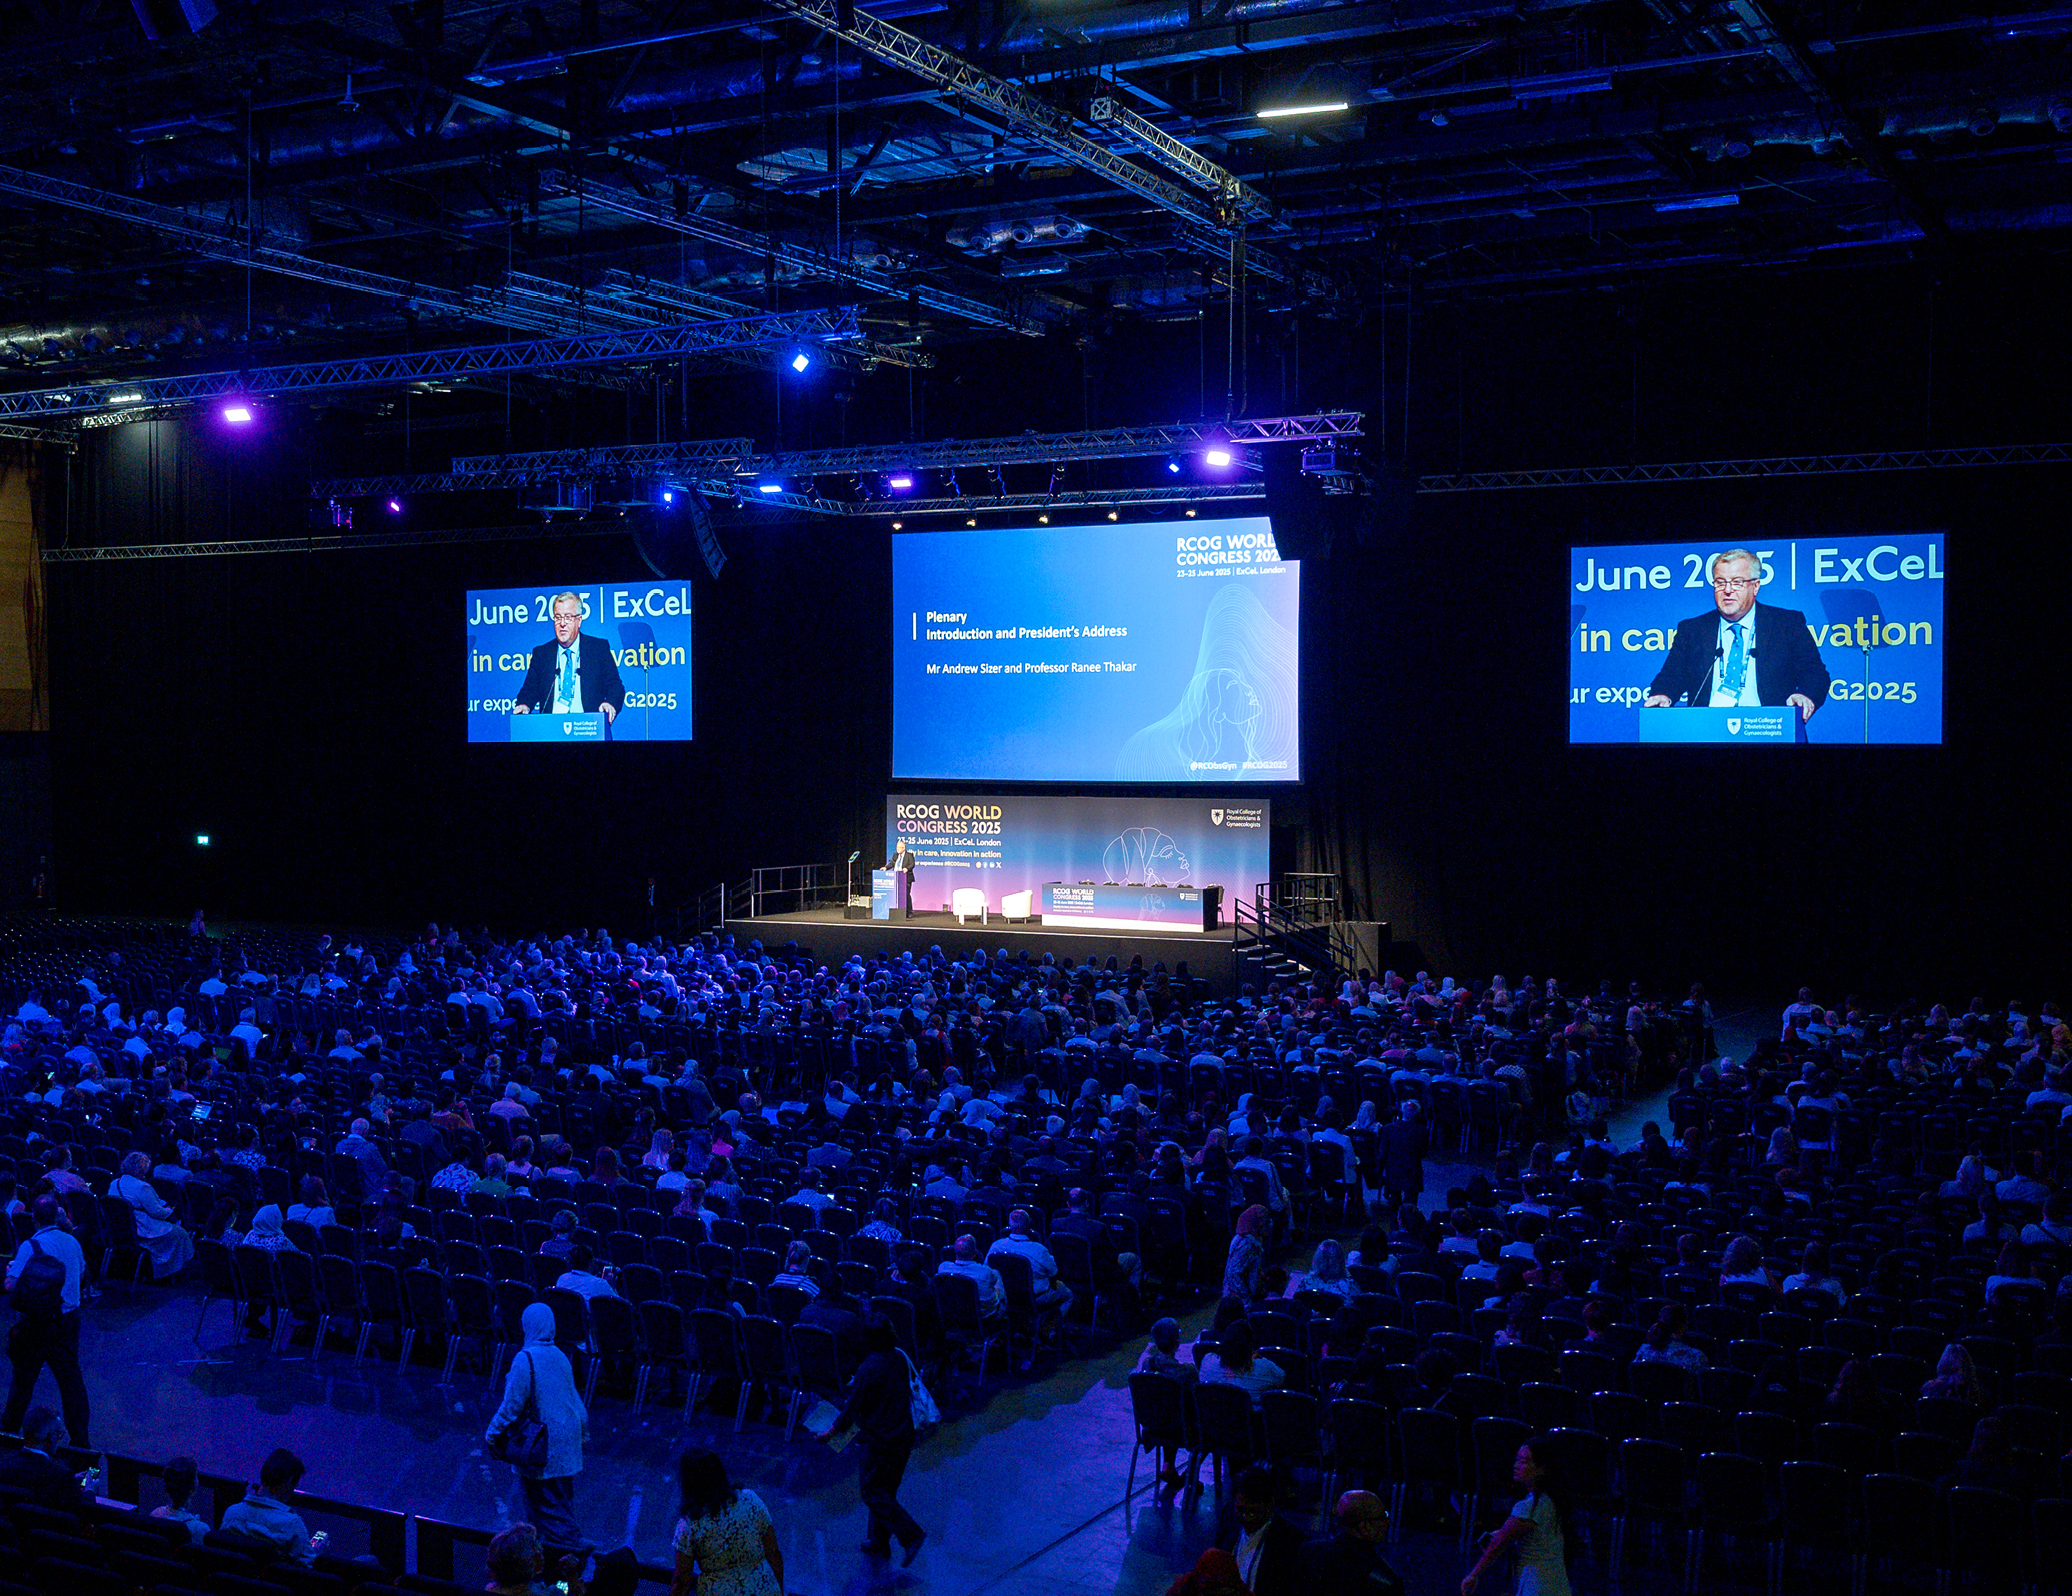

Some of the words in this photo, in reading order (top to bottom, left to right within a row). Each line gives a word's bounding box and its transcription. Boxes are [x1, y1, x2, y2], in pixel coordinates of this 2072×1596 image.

[1177, 536, 1222, 551] RCOG
[1177, 550, 1251, 565] CONGRESS
[1215, 568, 1231, 576] 2025
[1236, 567, 1258, 575] ExCeL
[1260, 566, 1286, 574] London
[1576, 559, 1671, 592] June
[1683, 550, 1774, 588] 205
[1814, 544, 1944, 583] ExCeL
[470, 599, 528, 625] June
[535, 593, 590, 622] 205
[614, 588, 691, 618] ExCeL
[926, 611, 967, 625] Plenary
[926, 628, 993, 640] Introduction
[995, 627, 1016, 638] and
[1019, 625, 1079, 638] President’s
[1082, 625, 1127, 637] Address
[1580, 623, 1610, 652] in
[473, 649, 492, 672] in
[926, 664, 941, 674] Mr
[942, 663, 978, 674] Andrew
[980, 663, 1002, 674] Sizer
[1004, 662, 1022, 673] and
[1025, 662, 1069, 673] Professor
[1071, 662, 1101, 672] Ranee
[1103, 661, 1137, 672] Thakar
[1190, 761, 1237, 771] @RCObsGyn
[1242, 761, 1287, 769] #RCOG2025
[897, 804, 939, 819] RCOG
[944, 805, 1002, 820] WORLD
[897, 820, 968, 834] CONGRESS
[972, 821, 1001, 834] 2025
[917, 837, 933, 845] June
[954, 838, 975, 846] ExCeL
